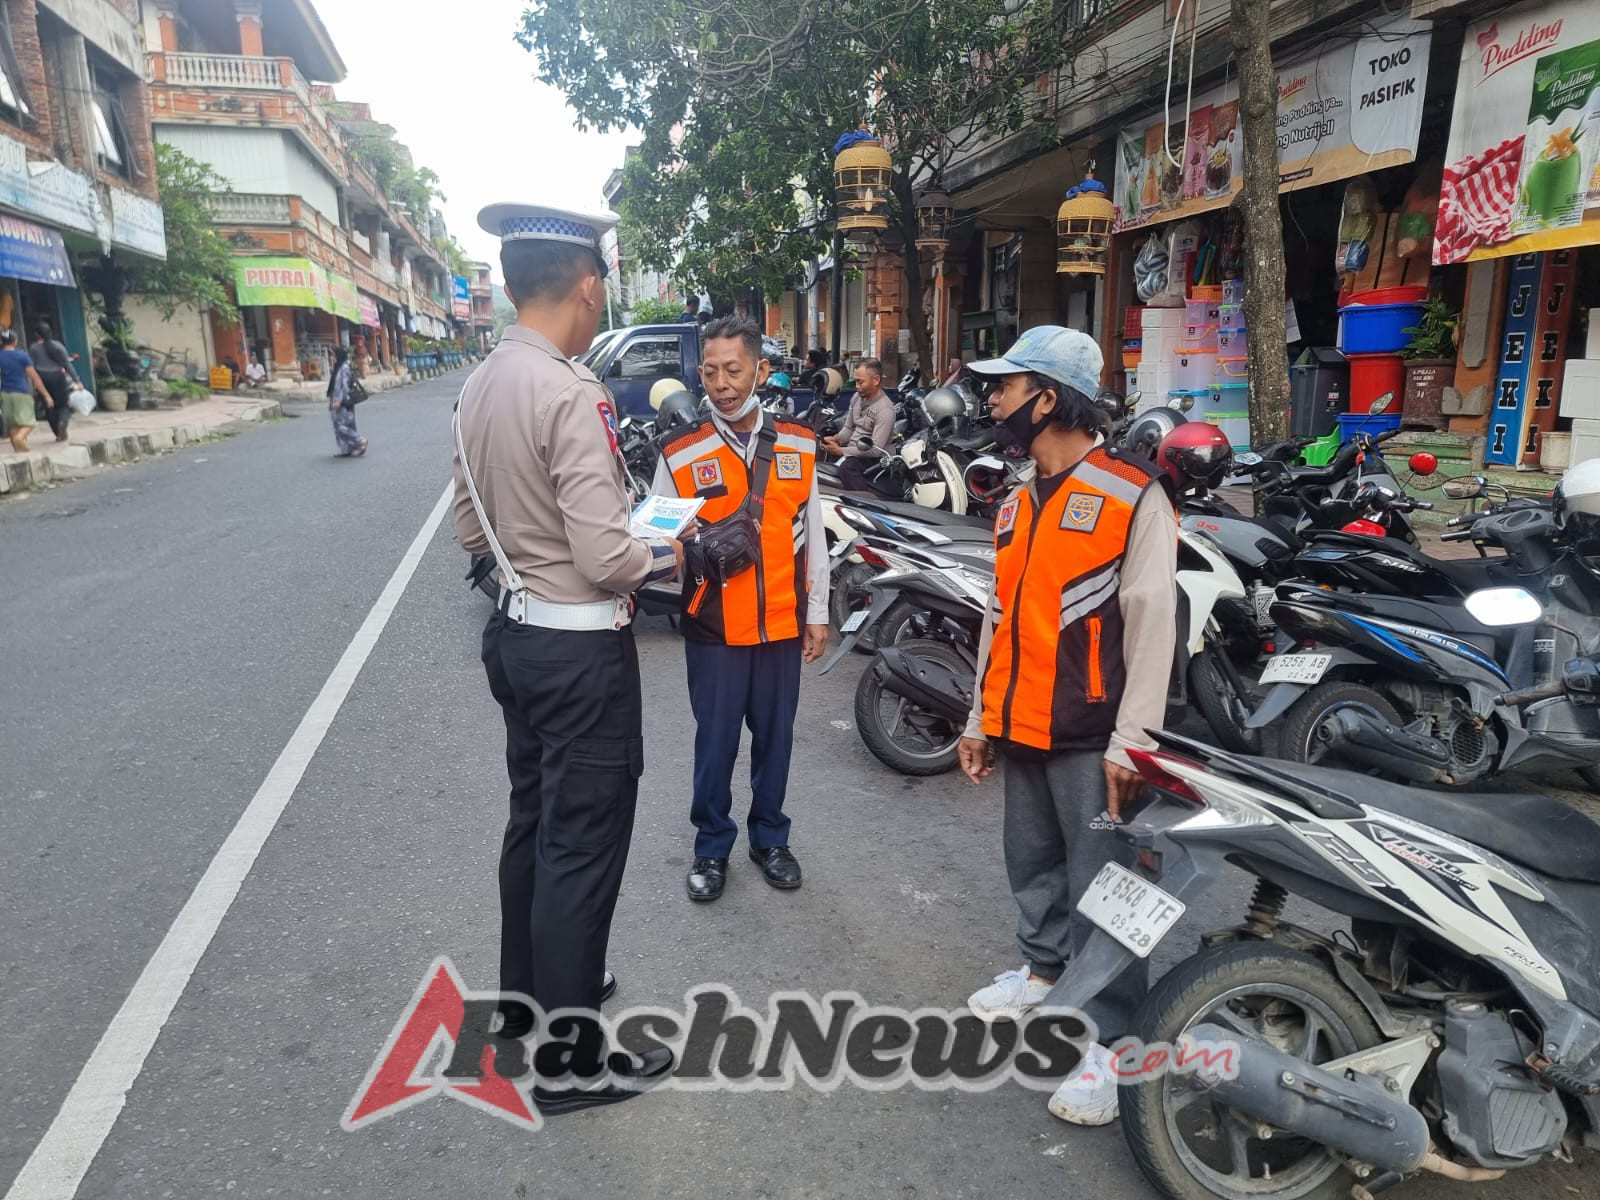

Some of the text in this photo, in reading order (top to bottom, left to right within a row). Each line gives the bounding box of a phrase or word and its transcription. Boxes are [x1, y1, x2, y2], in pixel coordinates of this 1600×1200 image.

[1481, 18, 1564, 76] Pudding
[1369, 47, 1411, 75] TOKO
[1359, 77, 1416, 110] PASIFIK
[1289, 101, 1324, 121] Pudding
[1290, 119, 1335, 144] Nutrijell
[245, 268, 306, 287] PUTRA
[1280, 656, 1306, 668] 5258
[1310, 657, 1327, 669] AB
[1089, 821, 1116, 830] adid
[1095, 867, 1177, 925] DK 6548 TF
